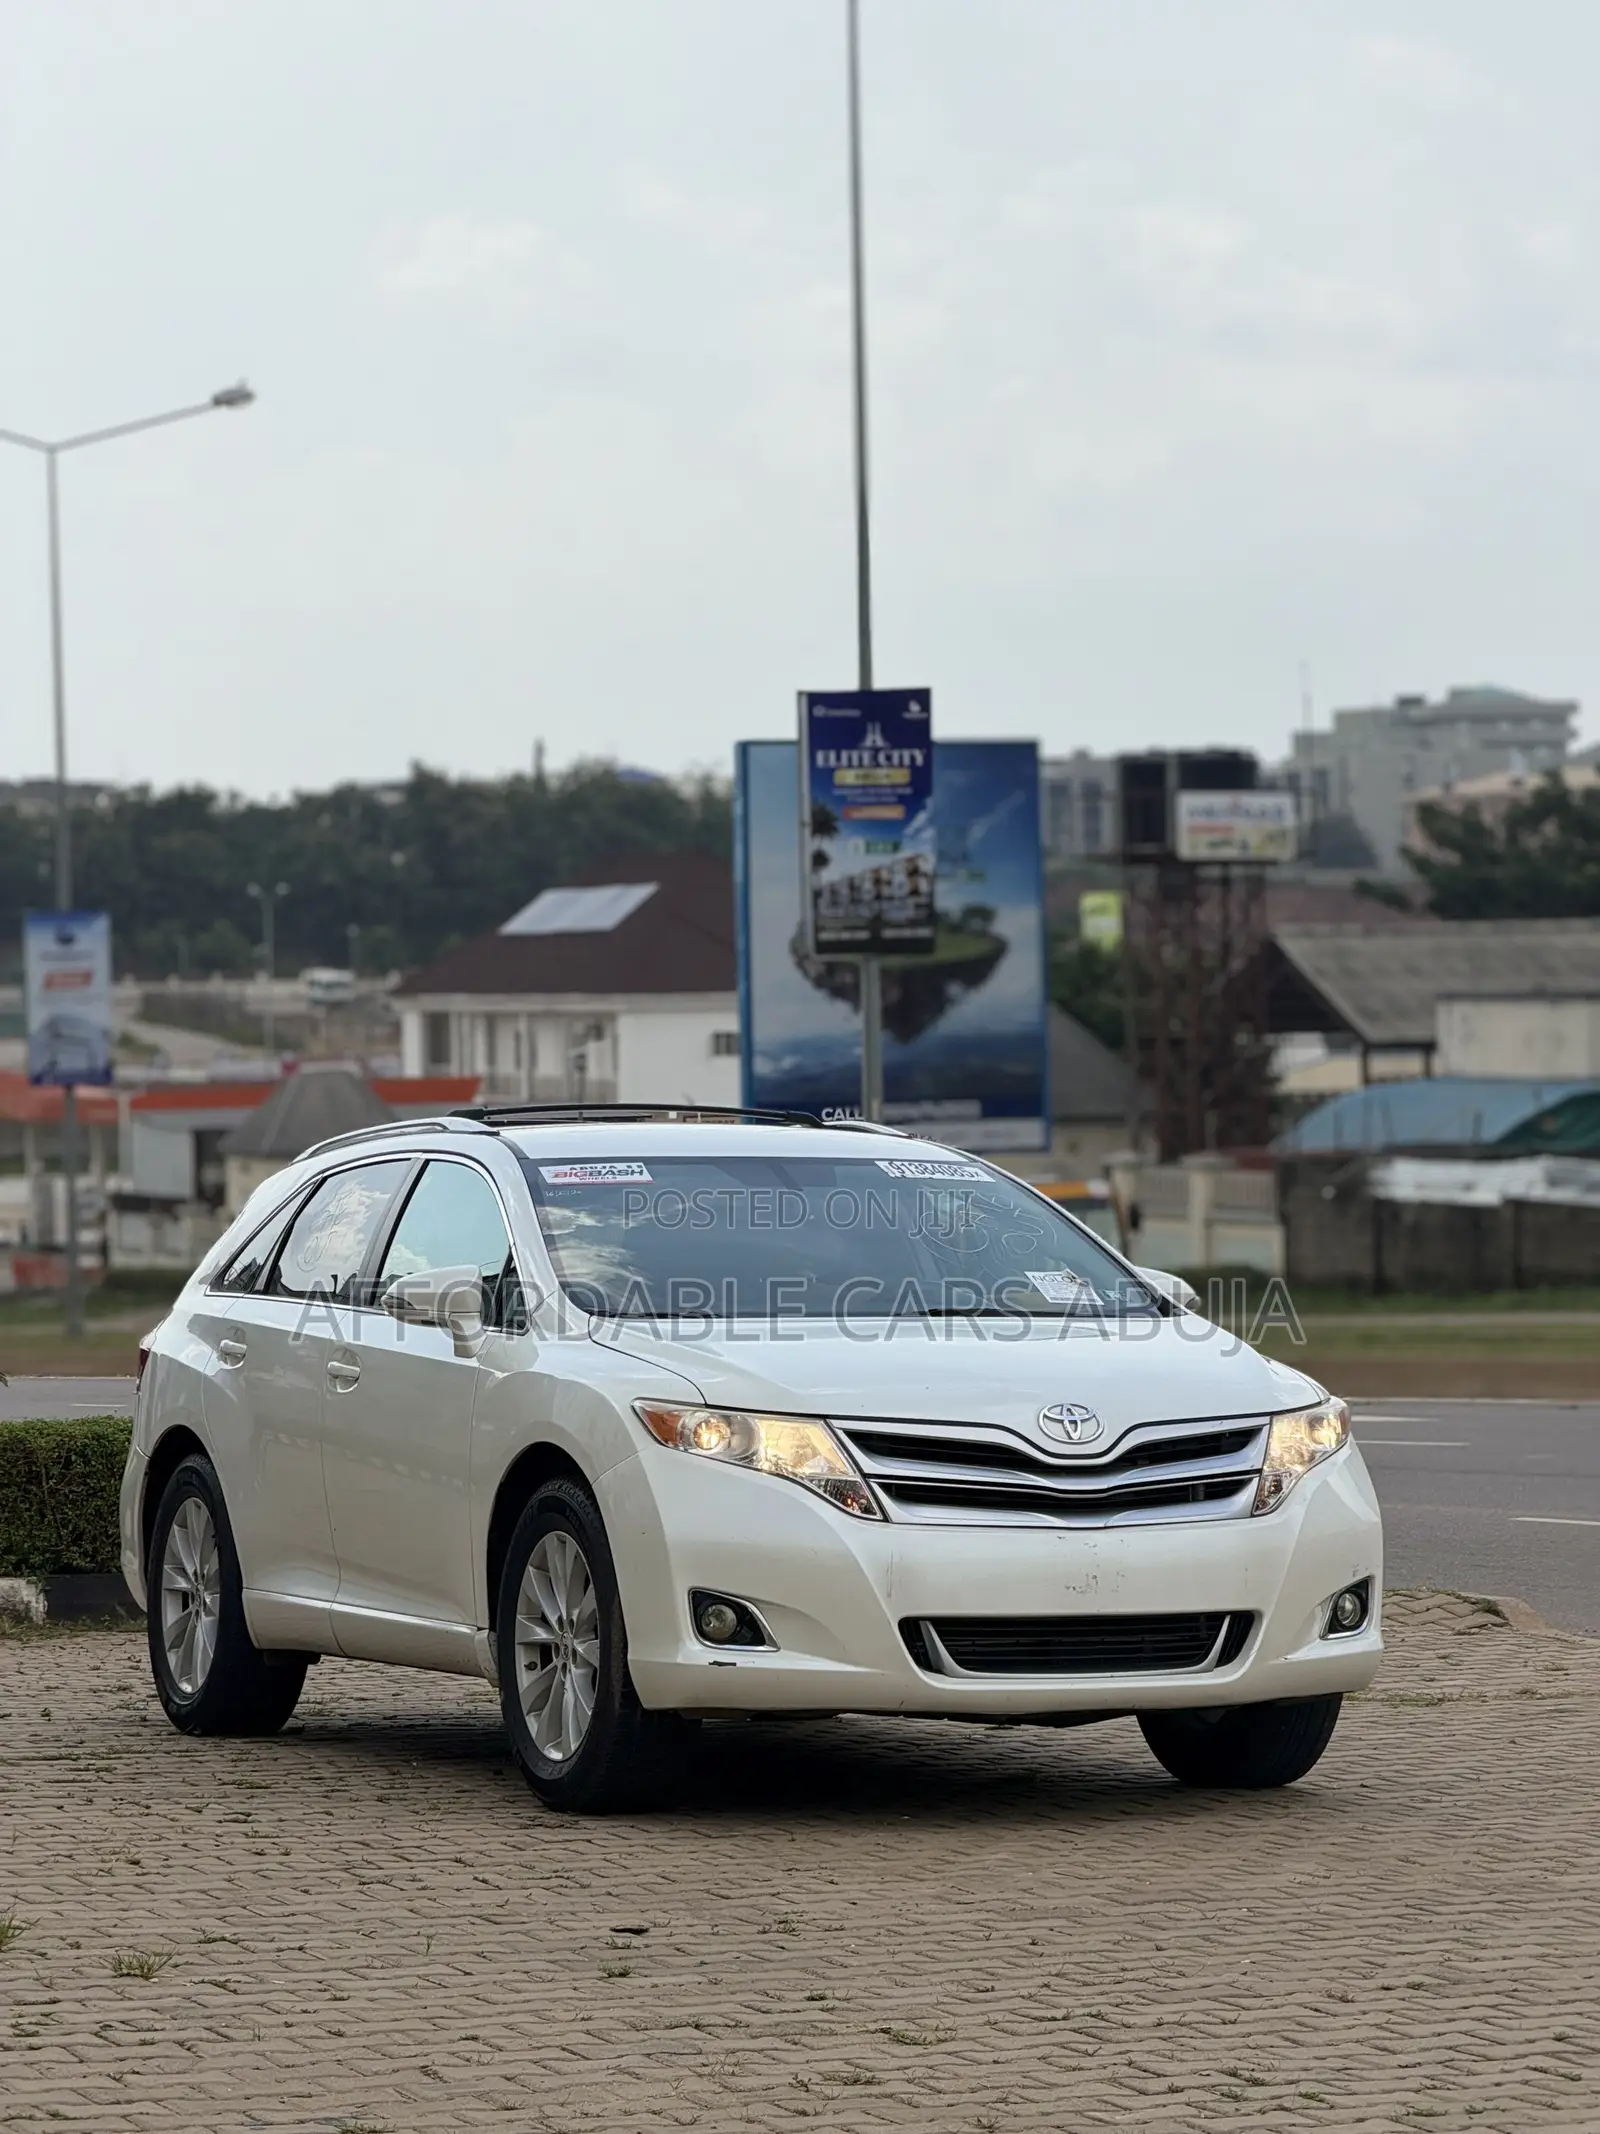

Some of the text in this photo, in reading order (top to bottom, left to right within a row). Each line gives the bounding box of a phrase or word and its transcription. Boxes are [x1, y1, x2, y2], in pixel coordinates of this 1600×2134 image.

[815, 747, 927, 768] ELITE CITY
[821, 1106, 865, 1121] CALL
[552, 1169, 644, 1178] BIGBASH
